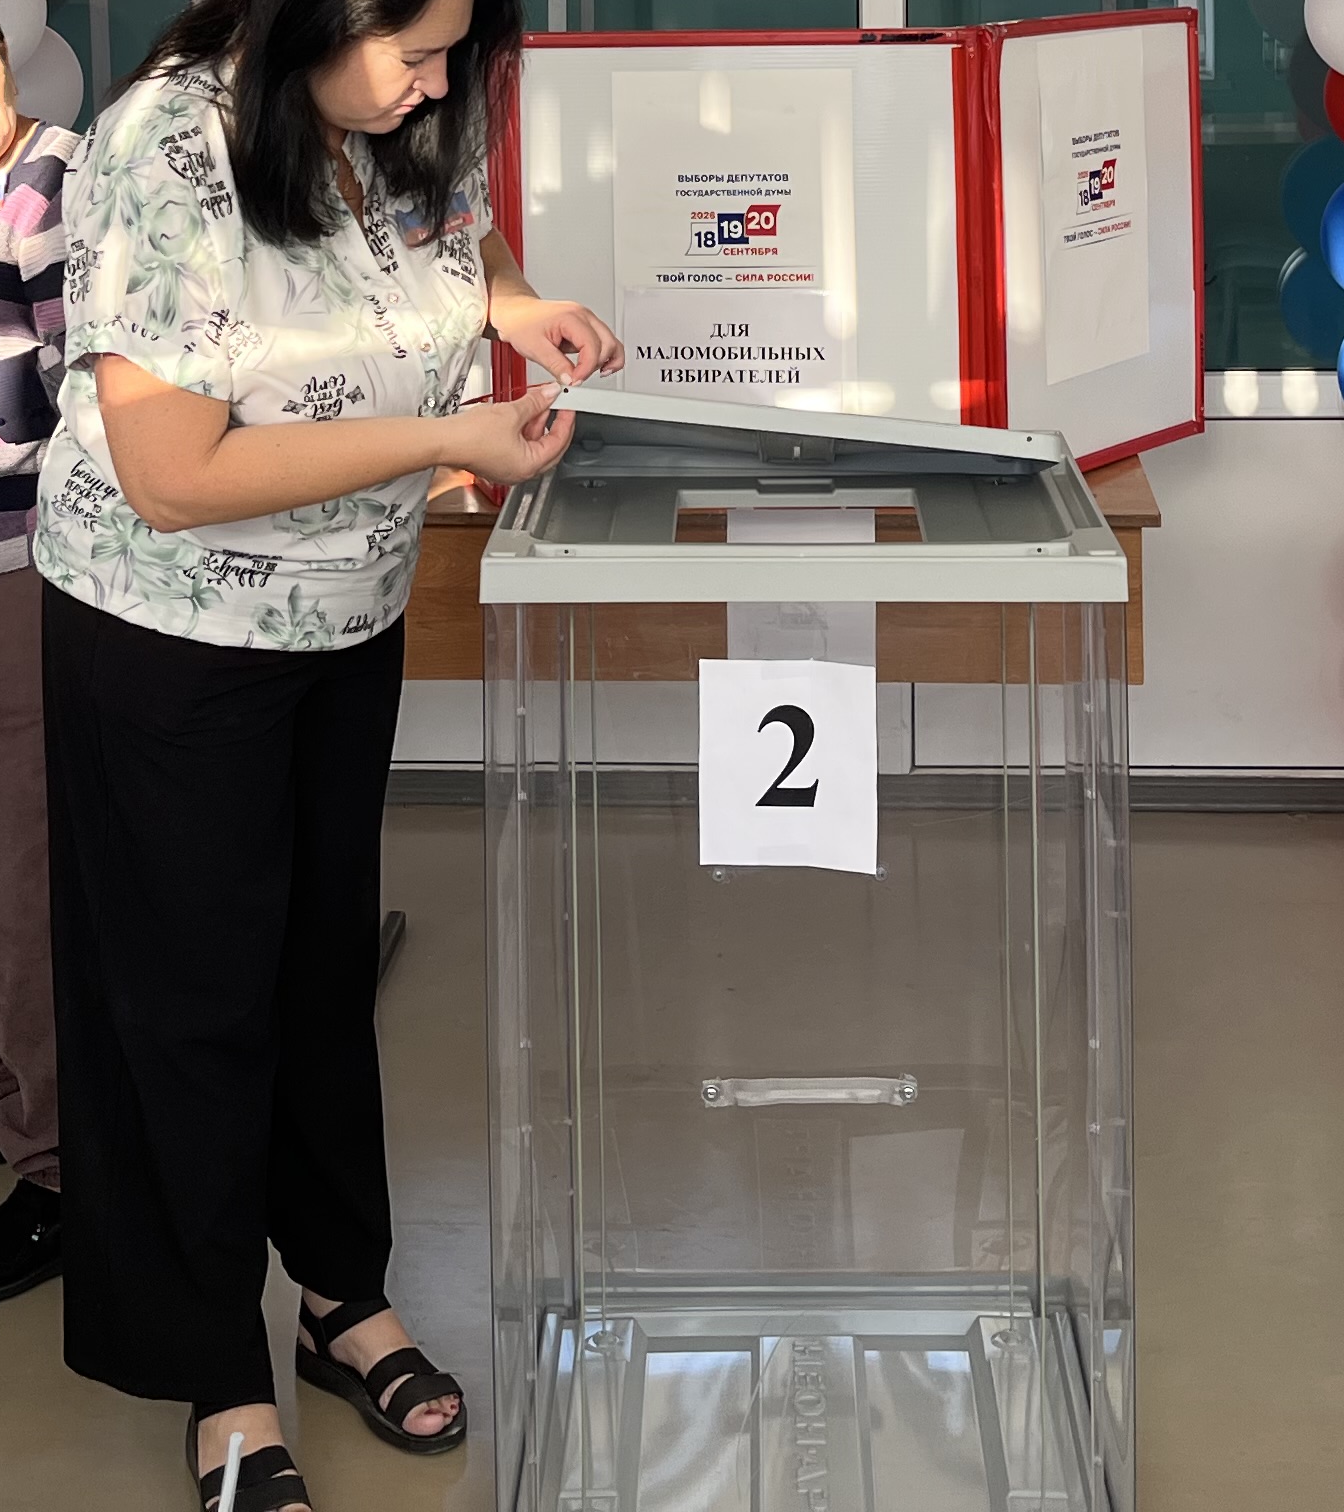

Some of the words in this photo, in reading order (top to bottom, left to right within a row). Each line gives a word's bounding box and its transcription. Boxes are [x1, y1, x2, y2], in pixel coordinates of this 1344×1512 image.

[677, 174, 724, 182] ВЫБОРЫ
[726, 173, 789, 183] ДЕПУТАТОВ
[1078, 189, 1090, 206] 18
[1090, 177, 1101, 195] 19
[1101, 165, 1114, 185] 20
[675, 187, 762, 197] ГОСУДАРСТВЕННОЙ
[764, 189, 791, 197] ДУМЫ
[694, 231, 716, 248] 18
[720, 220, 743, 239] 19
[747, 211, 775, 230] 20
[723, 247, 778, 256] СЕНТЯБРЯ
[656, 272, 685, 282] ТВОЙ
[687, 274, 723, 282] ГОЛОС
[735, 274, 764, 282] СИЛА
[709, 323, 750, 339] ДЛЯ
[635, 345, 826, 361] МАЛОМОБИЛЬНЫХ
[660, 366, 801, 384] ИЗБИРАТЕЛЕЙ
[755, 704, 819, 808] 2
